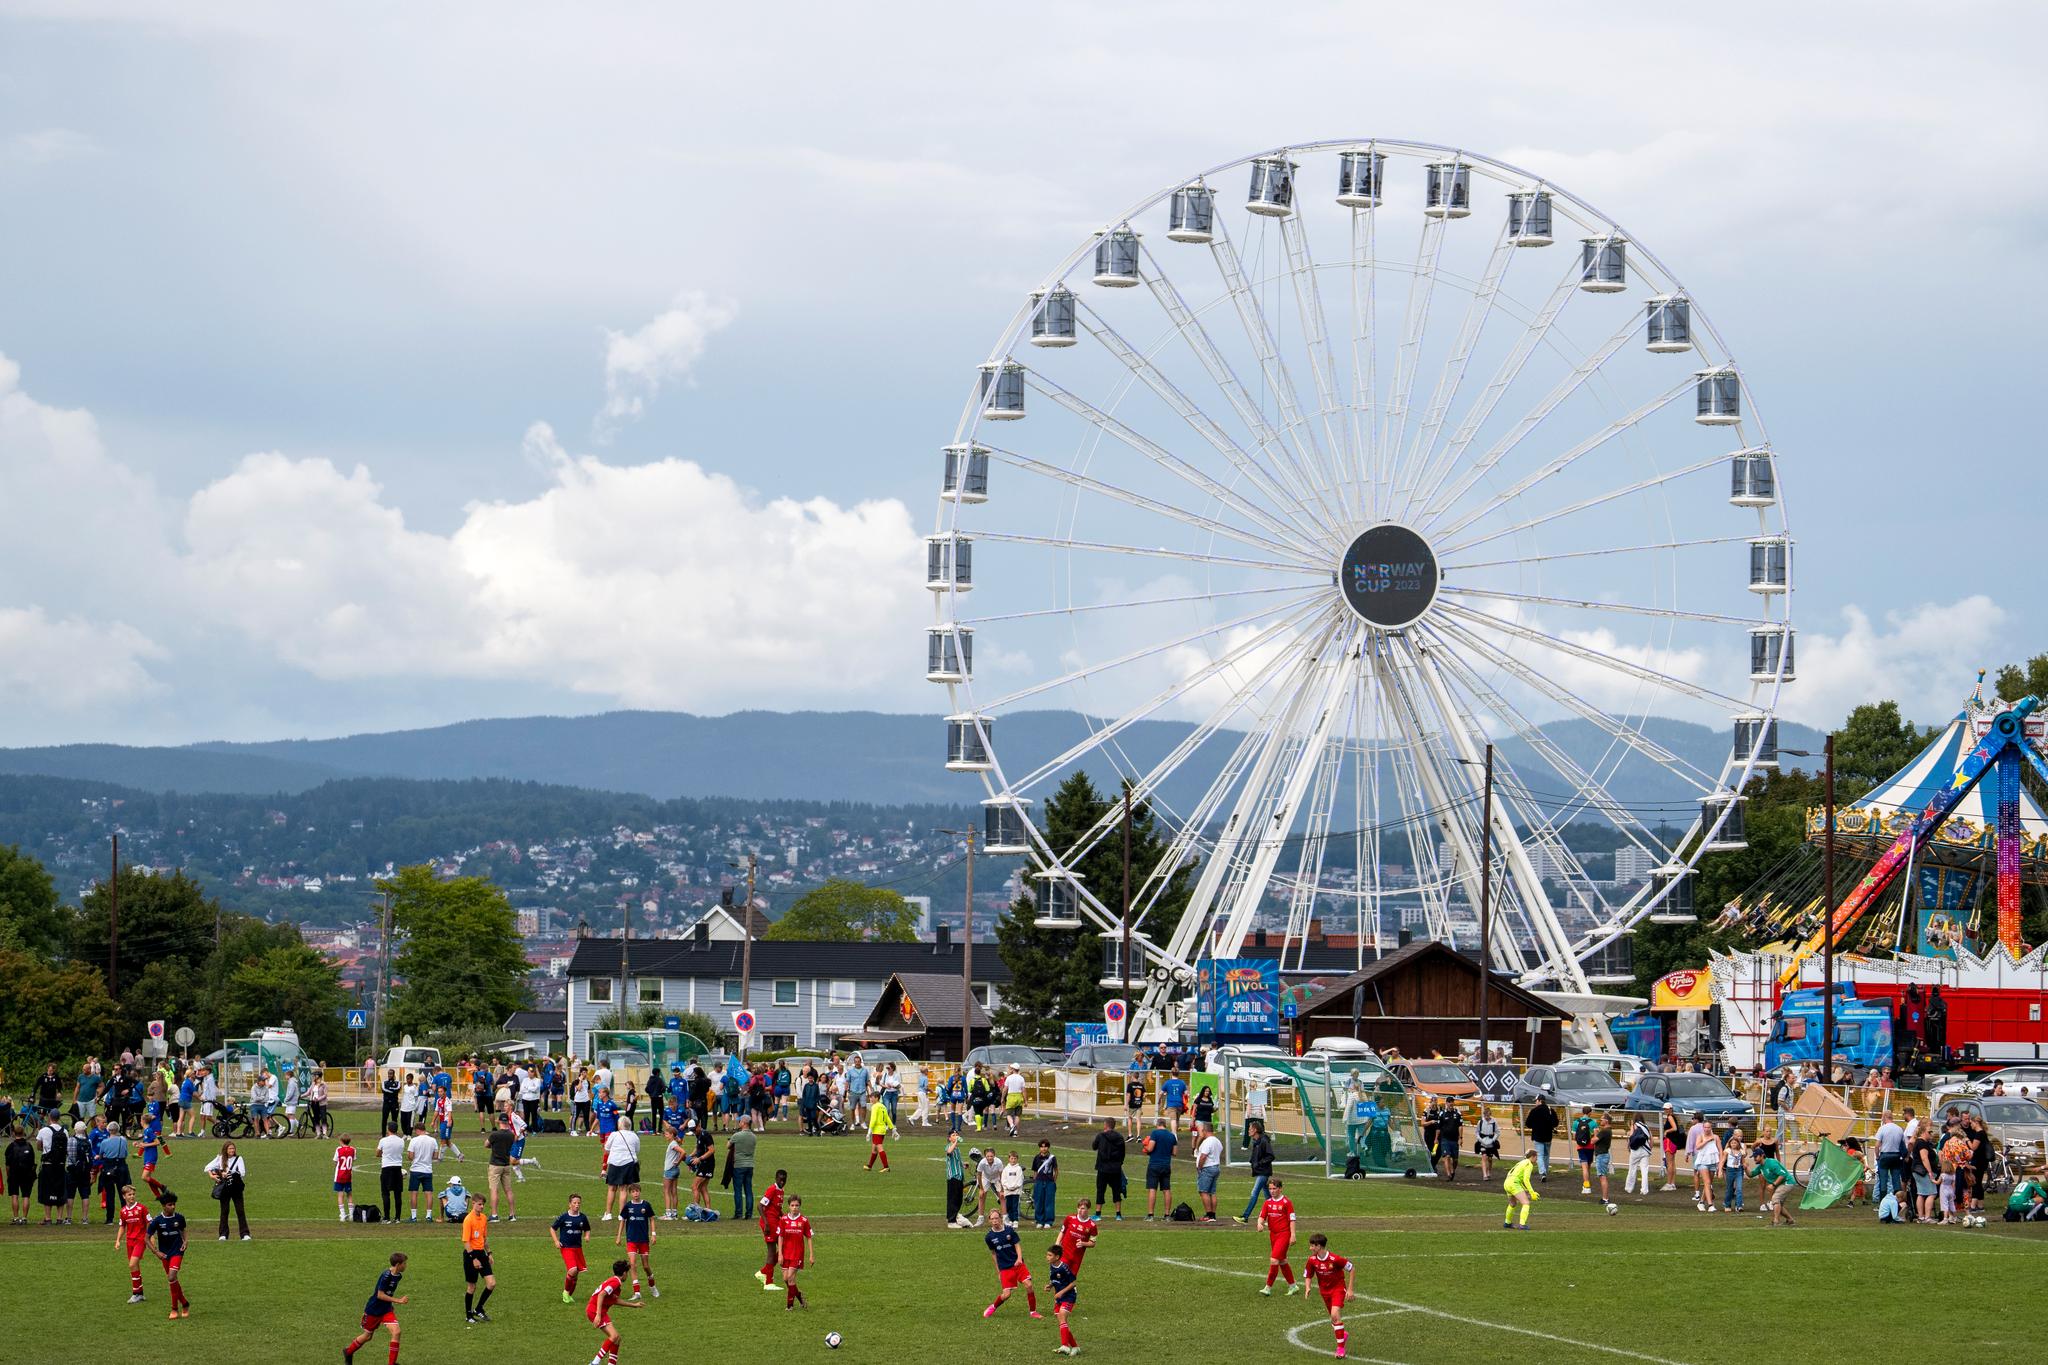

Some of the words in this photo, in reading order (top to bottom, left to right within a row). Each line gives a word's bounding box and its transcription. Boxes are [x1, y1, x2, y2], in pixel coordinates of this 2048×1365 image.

[1355, 580, 1391, 593] CUP
[1395, 581, 1420, 590] 2023
[1233, 1001, 1250, 1013] SPAR
[1251, 1001, 1261, 1013] TID
[340, 1155, 353, 1171] 20
